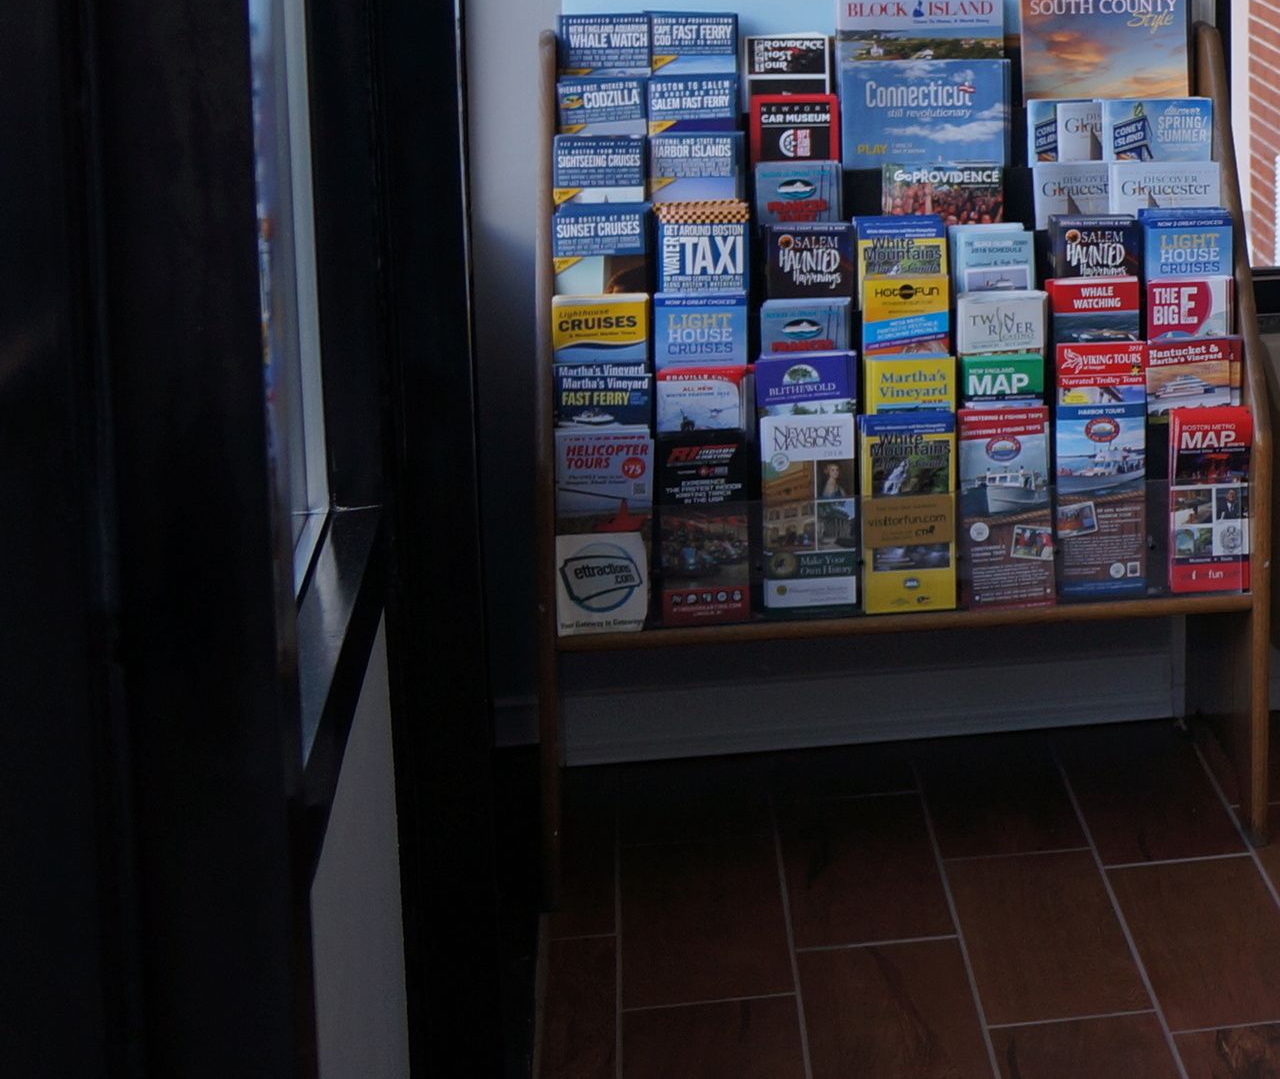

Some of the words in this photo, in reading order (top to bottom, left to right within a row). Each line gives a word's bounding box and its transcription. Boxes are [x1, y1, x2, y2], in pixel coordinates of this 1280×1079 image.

[848, 1, 908, 18] BLOCK
[928, 0, 994, 17] ISLAND
[1030, 0, 1094, 16] SOUTH
[1126, 8, 1174, 33] Style
[654, 25, 671, 35] CAPE
[672, 25, 697, 40] FAST
[699, 25, 733, 39] FERRY
[570, 34, 608, 48] WHALE
[610, 33, 648, 47] WATCH
[654, 35, 672, 46] COD
[600, 82, 623, 91] WICKED
[651, 82, 685, 92] BOSTON
[688, 81, 699, 91] TO
[702, 80, 730, 90] SALEM
[583, 88, 640, 109] CODZILLA
[865, 79, 974, 108] Connecticut
[651, 97, 680, 111] SALEM
[682, 96, 701, 109] FAST
[703, 95, 730, 108] FERRY
[761, 105, 831, 113] NEWPORT
[761, 114, 784, 124] CAR
[785, 113, 831, 123] MUSEUM
[887, 108, 903, 118] still
[906, 108, 972, 119] revolutionary
[1114, 121, 1143, 137] CONEY
[1157, 129, 1208, 143] SUMMER
[1114, 131, 1144, 147] ISLAND
[691, 144, 731, 157] ISLANDS
[857, 144, 888, 154] PLAY
[558, 155, 606, 168] SIGHTSEEING
[608, 154, 641, 166] CRUISES
[1143, 175, 1198, 183] DISCOVER
[1042, 181, 1108, 197] Gloucest
[1121, 180, 1210, 197] Gloucester
[556, 223, 596, 238] SUNSET
[597, 221, 640, 236] CRUISES
[663, 225, 679, 235] GET
[679, 225, 711, 236] AROUND
[712, 224, 744, 235] BOSTON
[794, 236, 839, 249] SALEM
[872, 237, 915, 250] White
[1081, 231, 1124, 243] SALEM
[1160, 233, 1220, 249] LIGHT
[663, 237, 680, 275] WATER
[680, 236, 744, 275] TAXI
[779, 249, 840, 273] HAUNTED
[864, 247, 942, 261] Mountains
[1066, 242, 1126, 266] HAUNTED
[1160, 248, 1220, 262] HOUSE
[1160, 261, 1220, 273] CRUISES
[792, 271, 842, 289] Happenings
[1081, 286, 1114, 297] WHALE
[1153, 287, 1179, 303] THE
[1073, 298, 1121, 309] WATCHING
[1180, 287, 1198, 324] E
[558, 308, 610, 319] Lighthouse
[1153, 304, 1179, 326] BIG
[558, 316, 637, 332] CRUISES
[668, 313, 732, 330] LIGHT
[668, 329, 733, 342] HOUSE
[668, 342, 733, 355] CRUISES
[1149, 346, 1201, 359] Nantucket
[1204, 344, 1218, 353] &
[1081, 354, 1113, 365] VIKING
[1114, 353, 1142, 364] TOURS
[1150, 356, 1185, 366] Martha's
[1187, 352, 1223, 363] Vineyard
[559, 365, 601, 376] Martha's
[880, 370, 946, 384] Martha's
[562, 377, 605, 389] Martha's
[607, 377, 649, 391] Vineyard
[969, 373, 1030, 395] MAP
[1062, 377, 1094, 387] Narrated
[1095, 376, 1121, 387] Trolley
[1122, 375, 1142, 384] Tours
[769, 382, 837, 397] BLITHEWOLD
[879, 384, 948, 401] Vineyard
[561, 392, 592, 406] FAST
[593, 392, 630, 405] FERRY
[772, 424, 843, 440] NEWPORT
[773, 436, 842, 451] MANSIONS
[879, 433, 924, 446] White
[1181, 431, 1237, 449] MAP
[565, 443, 649, 457] HELICOPTER
[870, 442, 951, 457] Mountains
[565, 457, 610, 469] TOURS
[624, 465, 642, 475] $75
[800, 557, 823, 566] Make
[825, 555, 846, 564] Your
[574, 562, 632, 580] ettractions
[800, 566, 822, 575] Own
[822, 565, 852, 576] History
[614, 574, 636, 585] .com
